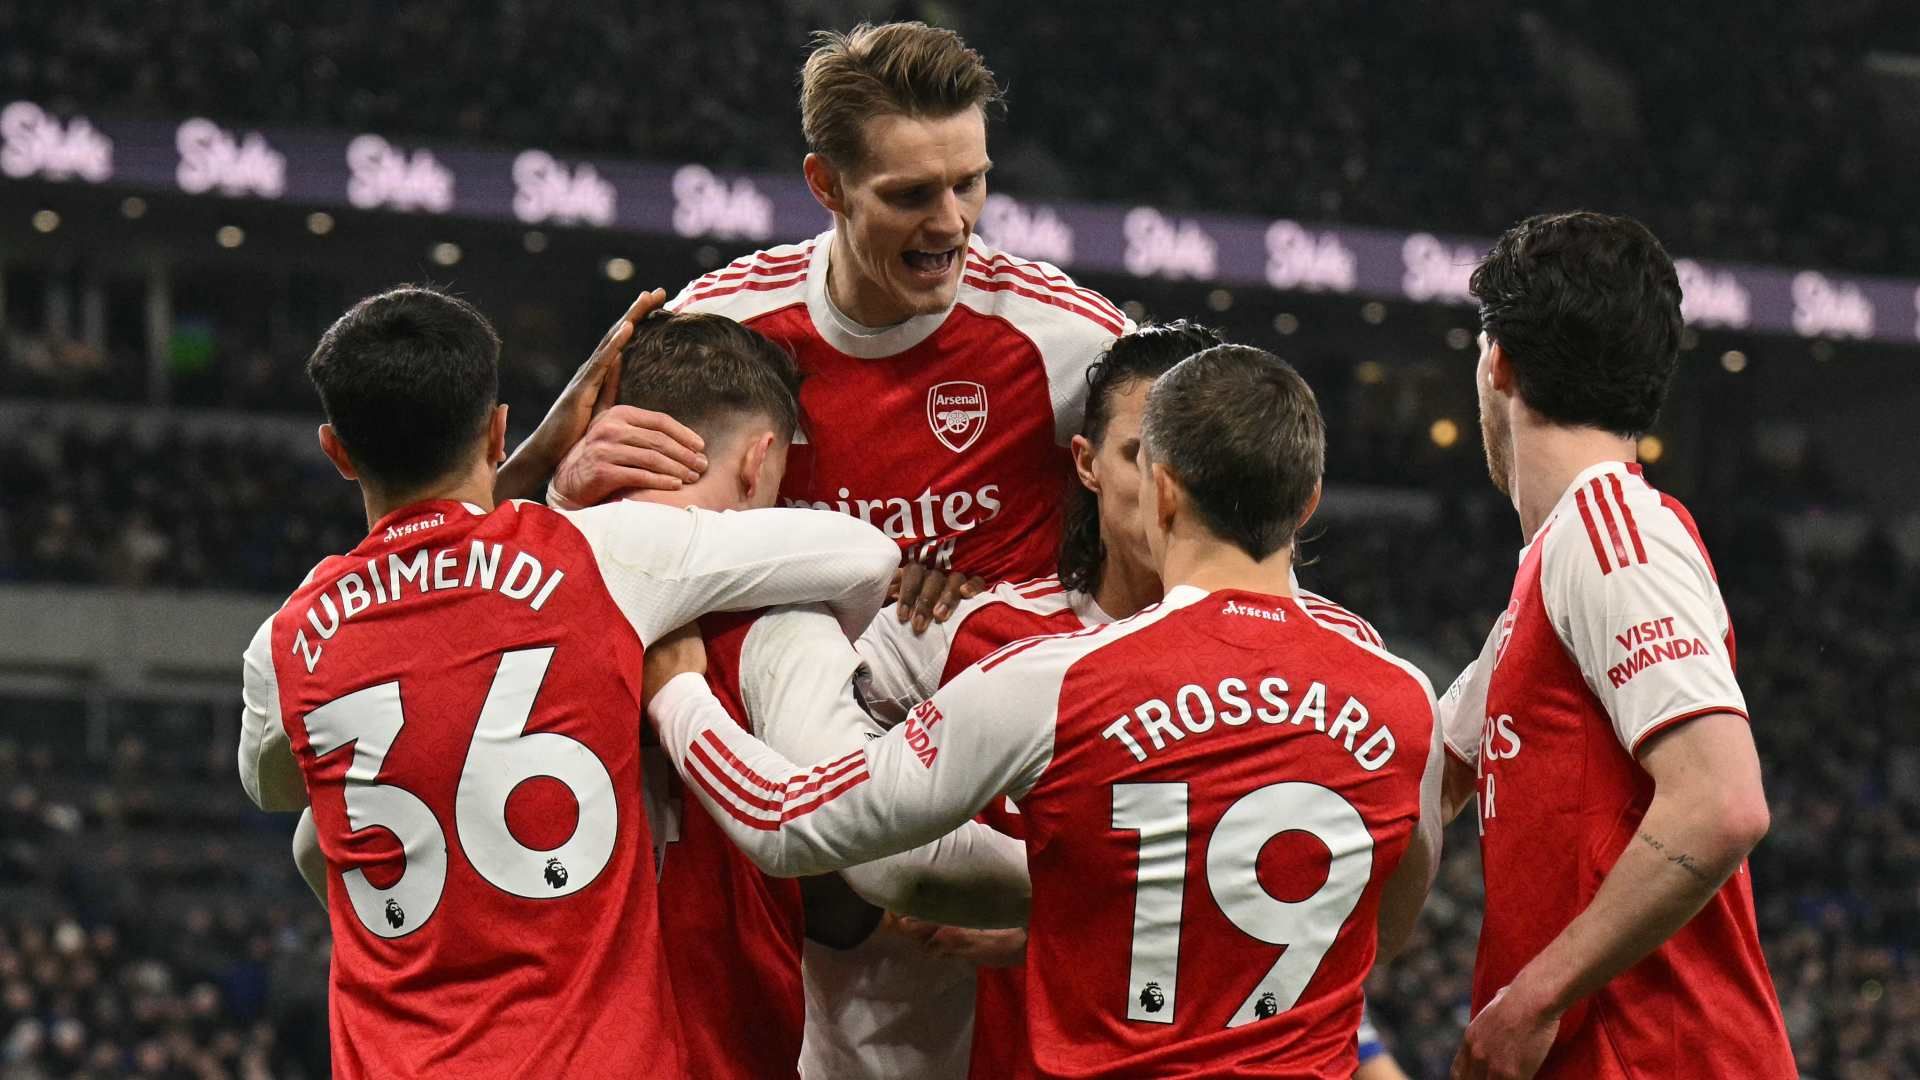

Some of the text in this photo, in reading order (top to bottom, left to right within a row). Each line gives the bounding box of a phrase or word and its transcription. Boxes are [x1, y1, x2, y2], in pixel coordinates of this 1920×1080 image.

[936, 393, 979, 406] Arsenal
[382, 513, 446, 543] Arsenal
[291, 540, 566, 674] ZUBIMENDI
[1221, 599, 1288, 624] Arsenal
[1615, 615, 1677, 652] VISIT
[1606, 637, 1710, 690] RWANDA
[913, 699, 944, 731] SIT
[1101, 676, 1397, 772] TROSSARD
[303, 646, 619, 940] 36
[1111, 780, 1376, 1030] 19
